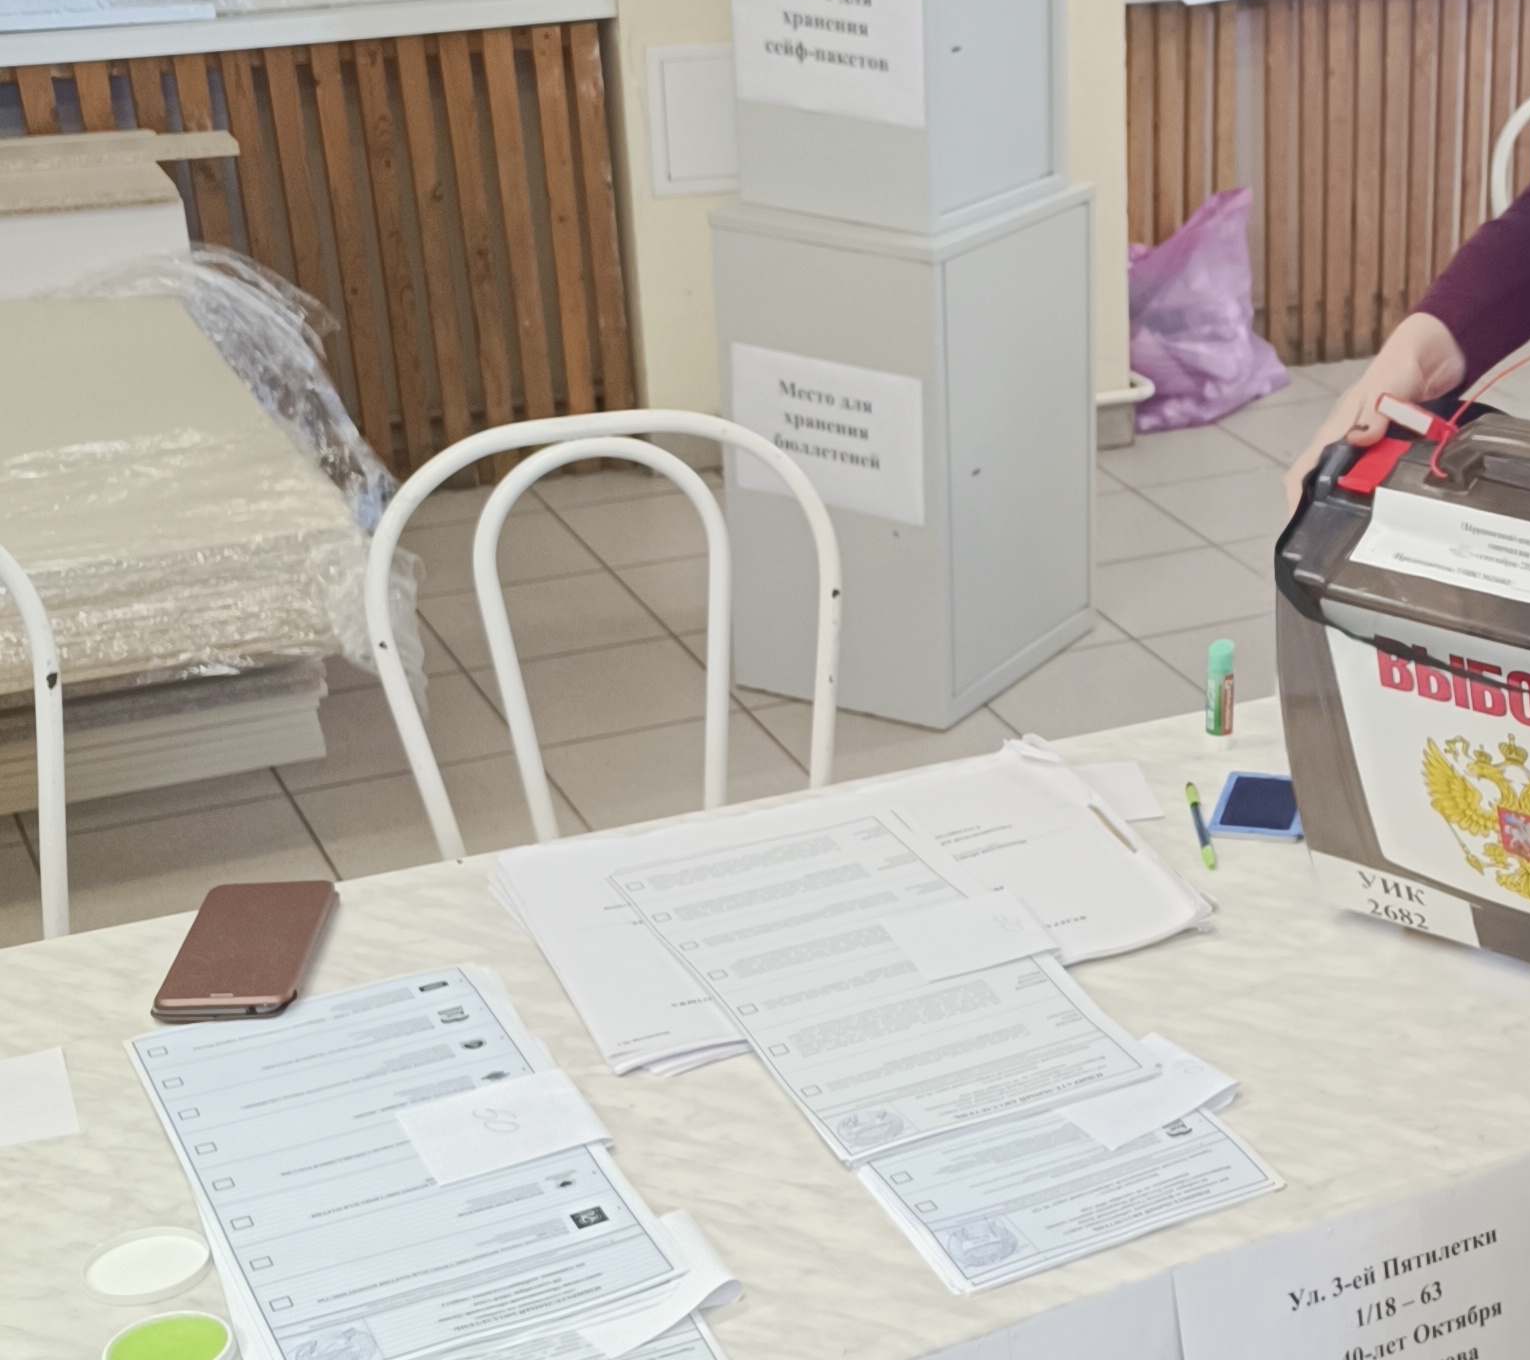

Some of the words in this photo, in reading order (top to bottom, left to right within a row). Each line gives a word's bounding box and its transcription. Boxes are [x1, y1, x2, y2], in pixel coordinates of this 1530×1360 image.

[783, 11, 868, 36] хранения
[765, 39, 889, 72] сейф-пакетов
[779, 379, 835, 406] Место
[840, 397, 872, 414] для
[785, 412, 868, 440] хранения
[774, 432, 880, 470] бюллетеней
[1359, 870, 1426, 906] УИК
[1368, 898, 1429, 930] 2682
[1288, 1288, 1326, 1311] Ул.
[1332, 1265, 1376, 1298] 3-ей
[1383, 1229, 1498, 1281] Пятилетки
[1355, 1297, 1397, 1328] 1/18
[1420, 1281, 1443, 1305] 63
[1413, 1301, 1503, 1344] Октября
